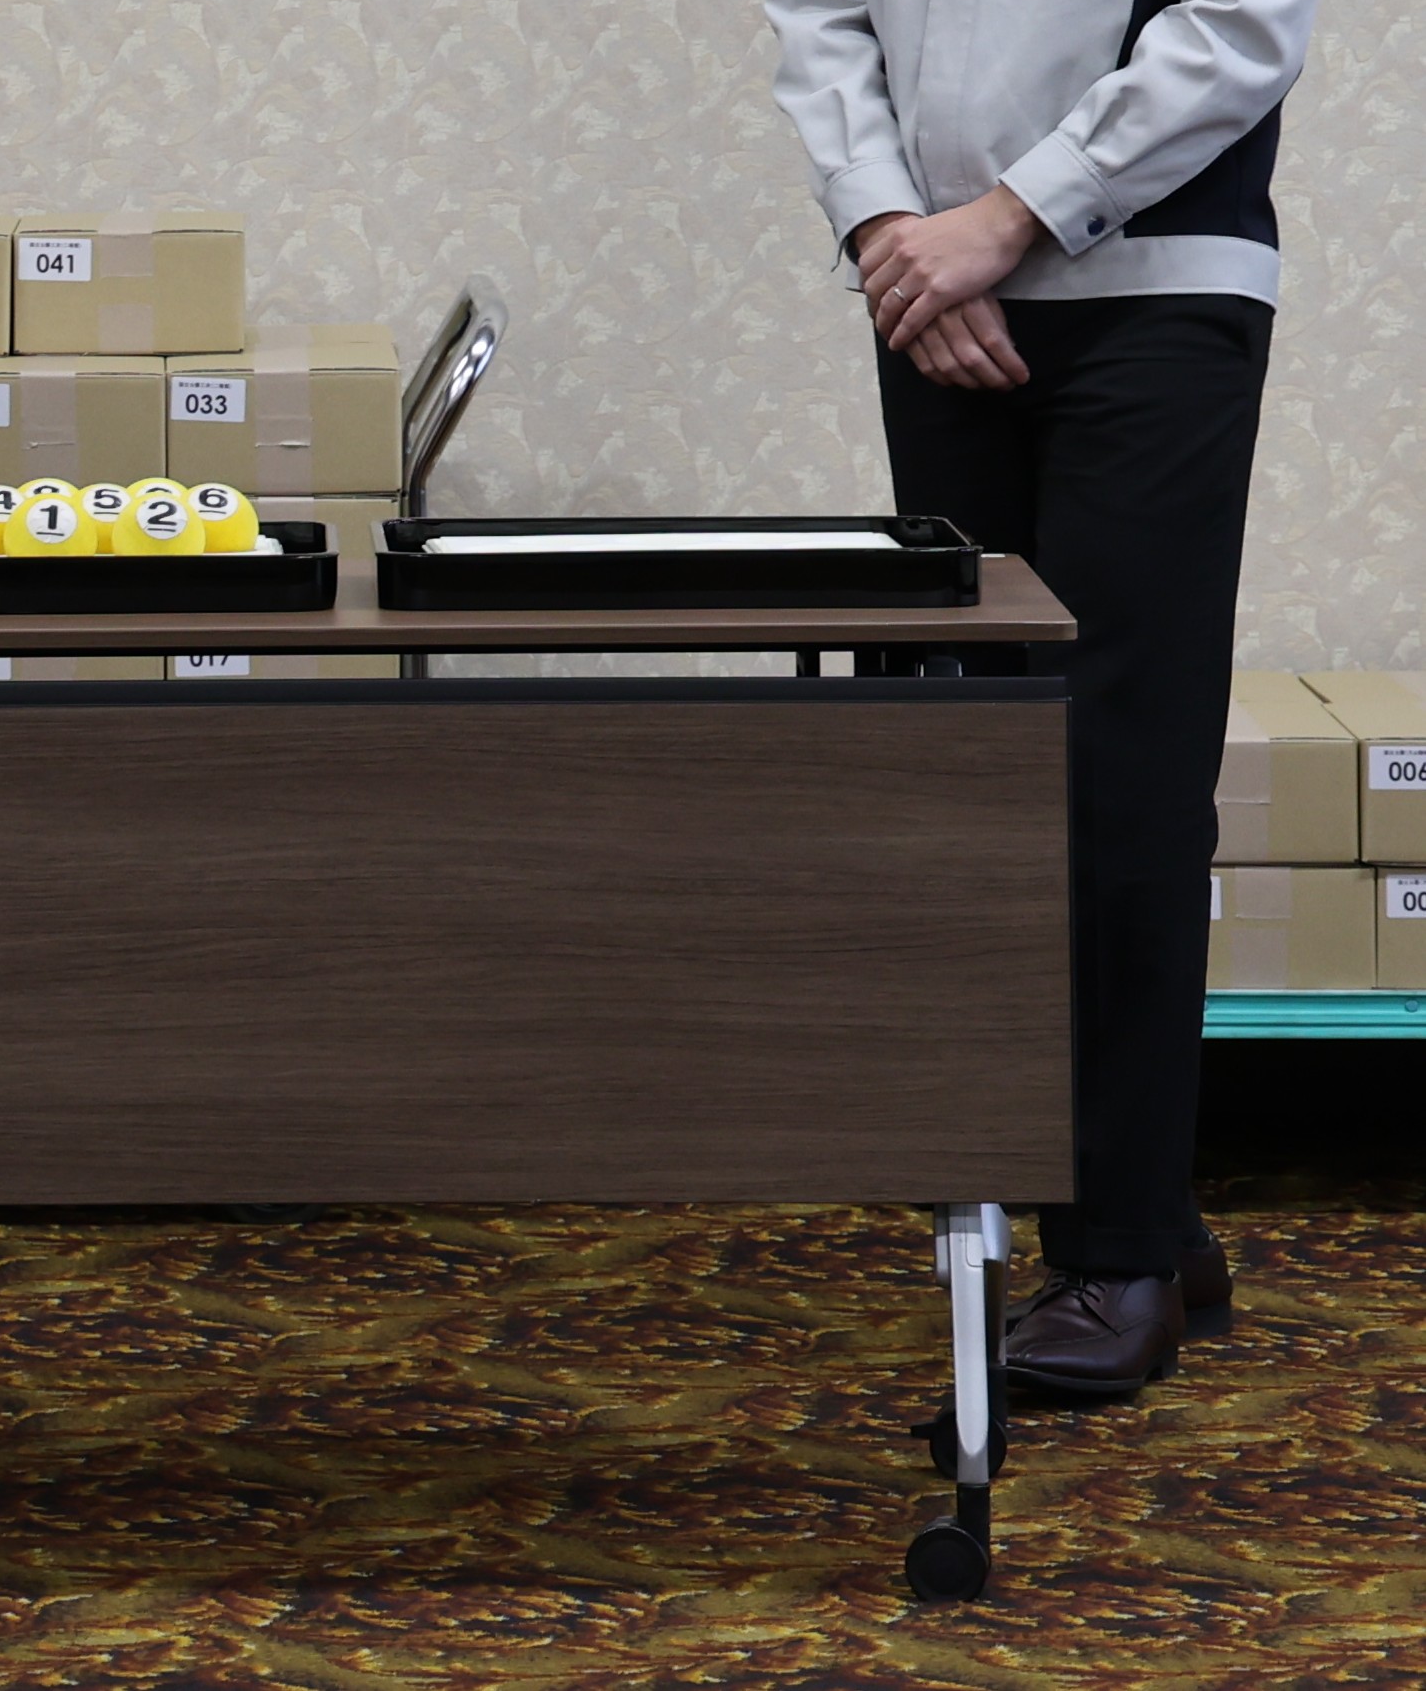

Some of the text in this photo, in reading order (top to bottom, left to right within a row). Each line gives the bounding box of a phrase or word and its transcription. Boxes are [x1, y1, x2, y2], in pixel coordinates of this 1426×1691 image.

[36, 253, 74, 273] 041
[185, 394, 227, 415] 033
[93, 488, 122, 509] 5
[198, 487, 228, 509] 6
[40, 504, 59, 530] 1
[147, 501, 177, 526] 2
[1403, 891, 1426, 912] 00
